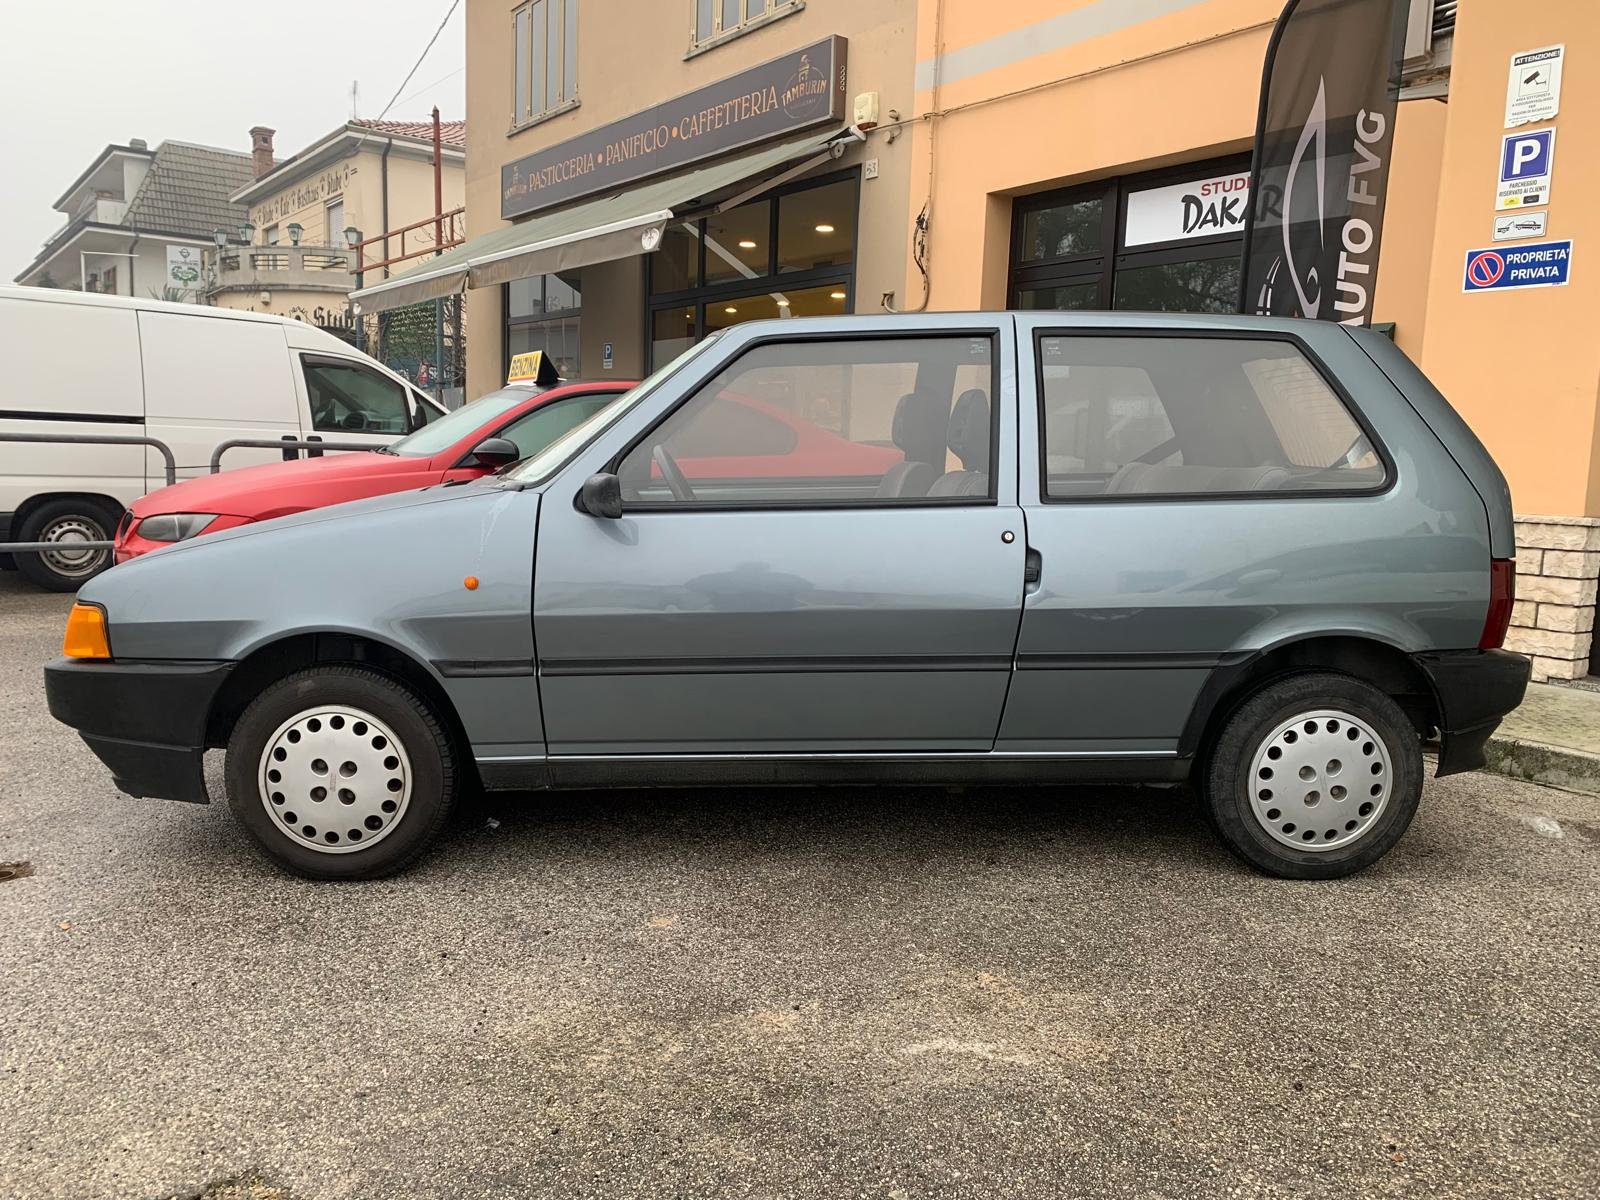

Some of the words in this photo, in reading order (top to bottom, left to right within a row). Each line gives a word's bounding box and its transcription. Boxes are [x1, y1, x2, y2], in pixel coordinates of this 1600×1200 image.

[1514, 50, 1561, 65] ATTENZIONE!
[781, 79, 827, 107] TAMBURIN
[529, 152, 595, 192] PASTICCERIA
[606, 124, 669, 166] PANIFICIO
[679, 85, 779, 140] CAFFETTERIA
[1347, 108, 1386, 206] FVG
[1512, 139, 1541, 175] P
[1201, 176, 1256, 196] STUDI
[1506, 248, 1570, 264] PROPRIETA'
[1510, 266, 1559, 280] PRIVATA
[510, 354, 539, 377] BENZINA
